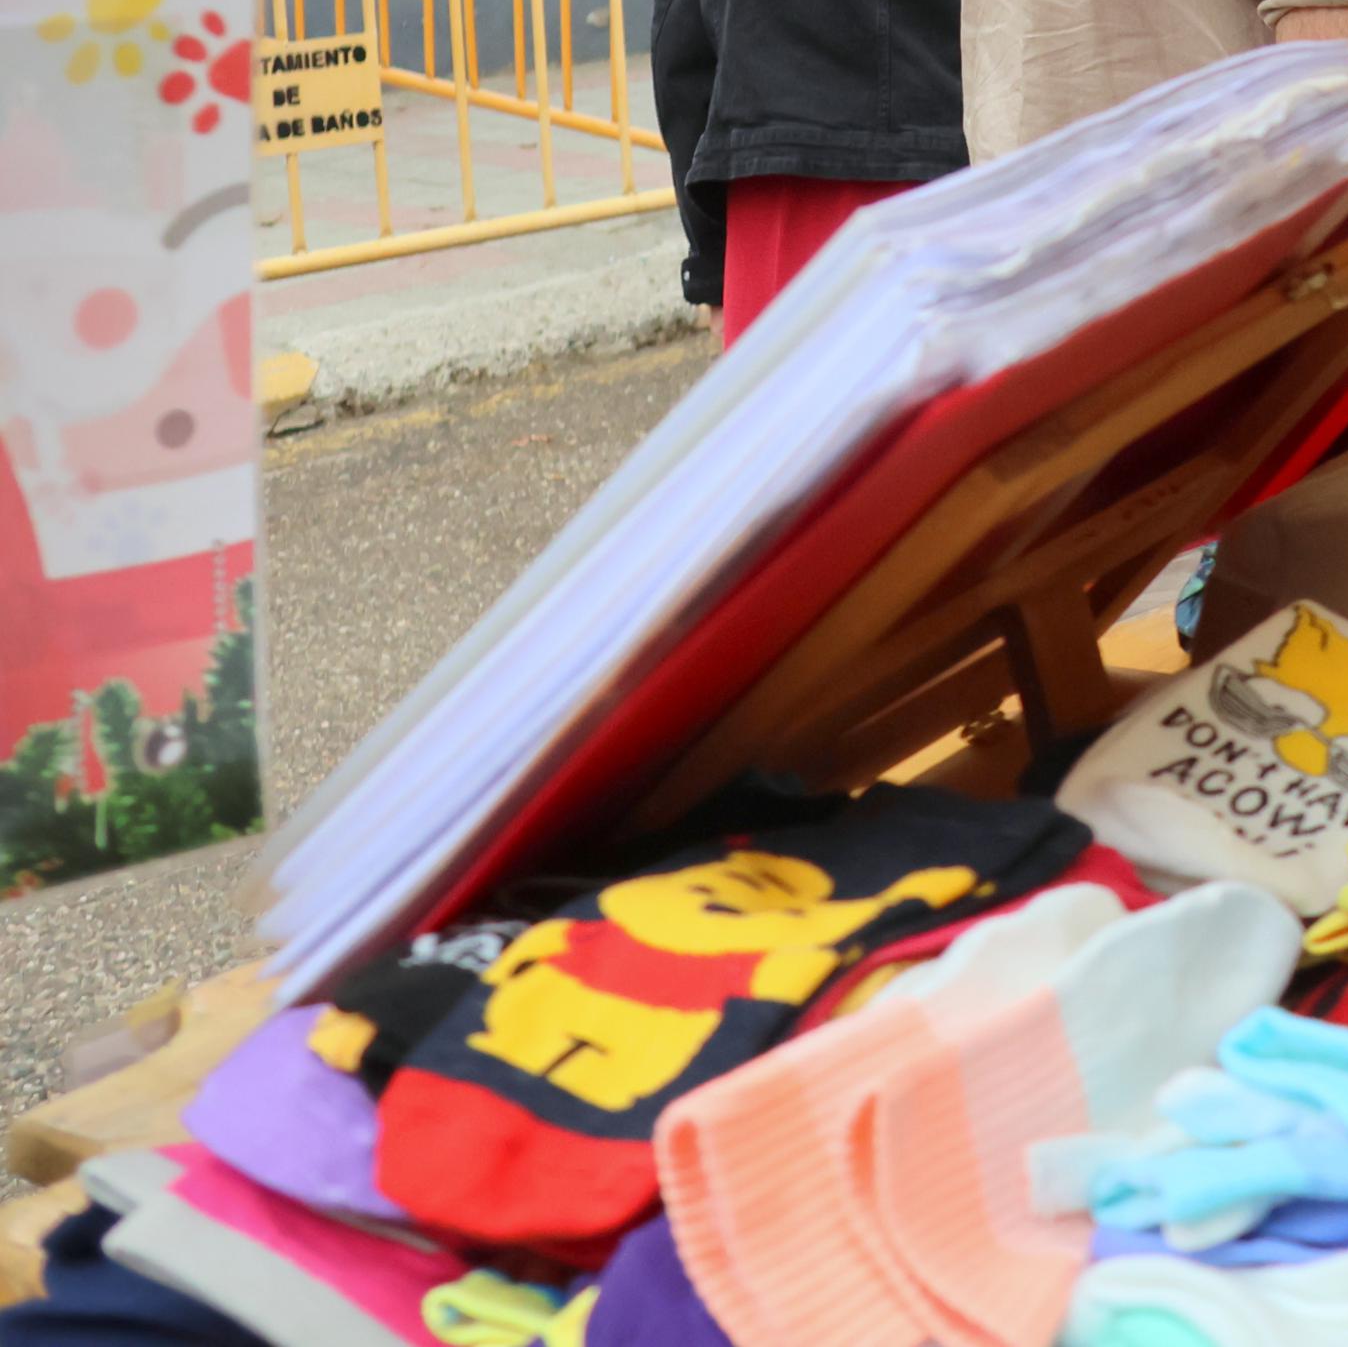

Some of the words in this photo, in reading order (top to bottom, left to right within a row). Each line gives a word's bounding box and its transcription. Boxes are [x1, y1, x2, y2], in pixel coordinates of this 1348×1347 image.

[261, 45, 367, 75] TAMIENTO
[273, 85, 300, 107] DE
[276, 118, 305, 139] DE
[311, 109, 383, 134] BAÑOS
